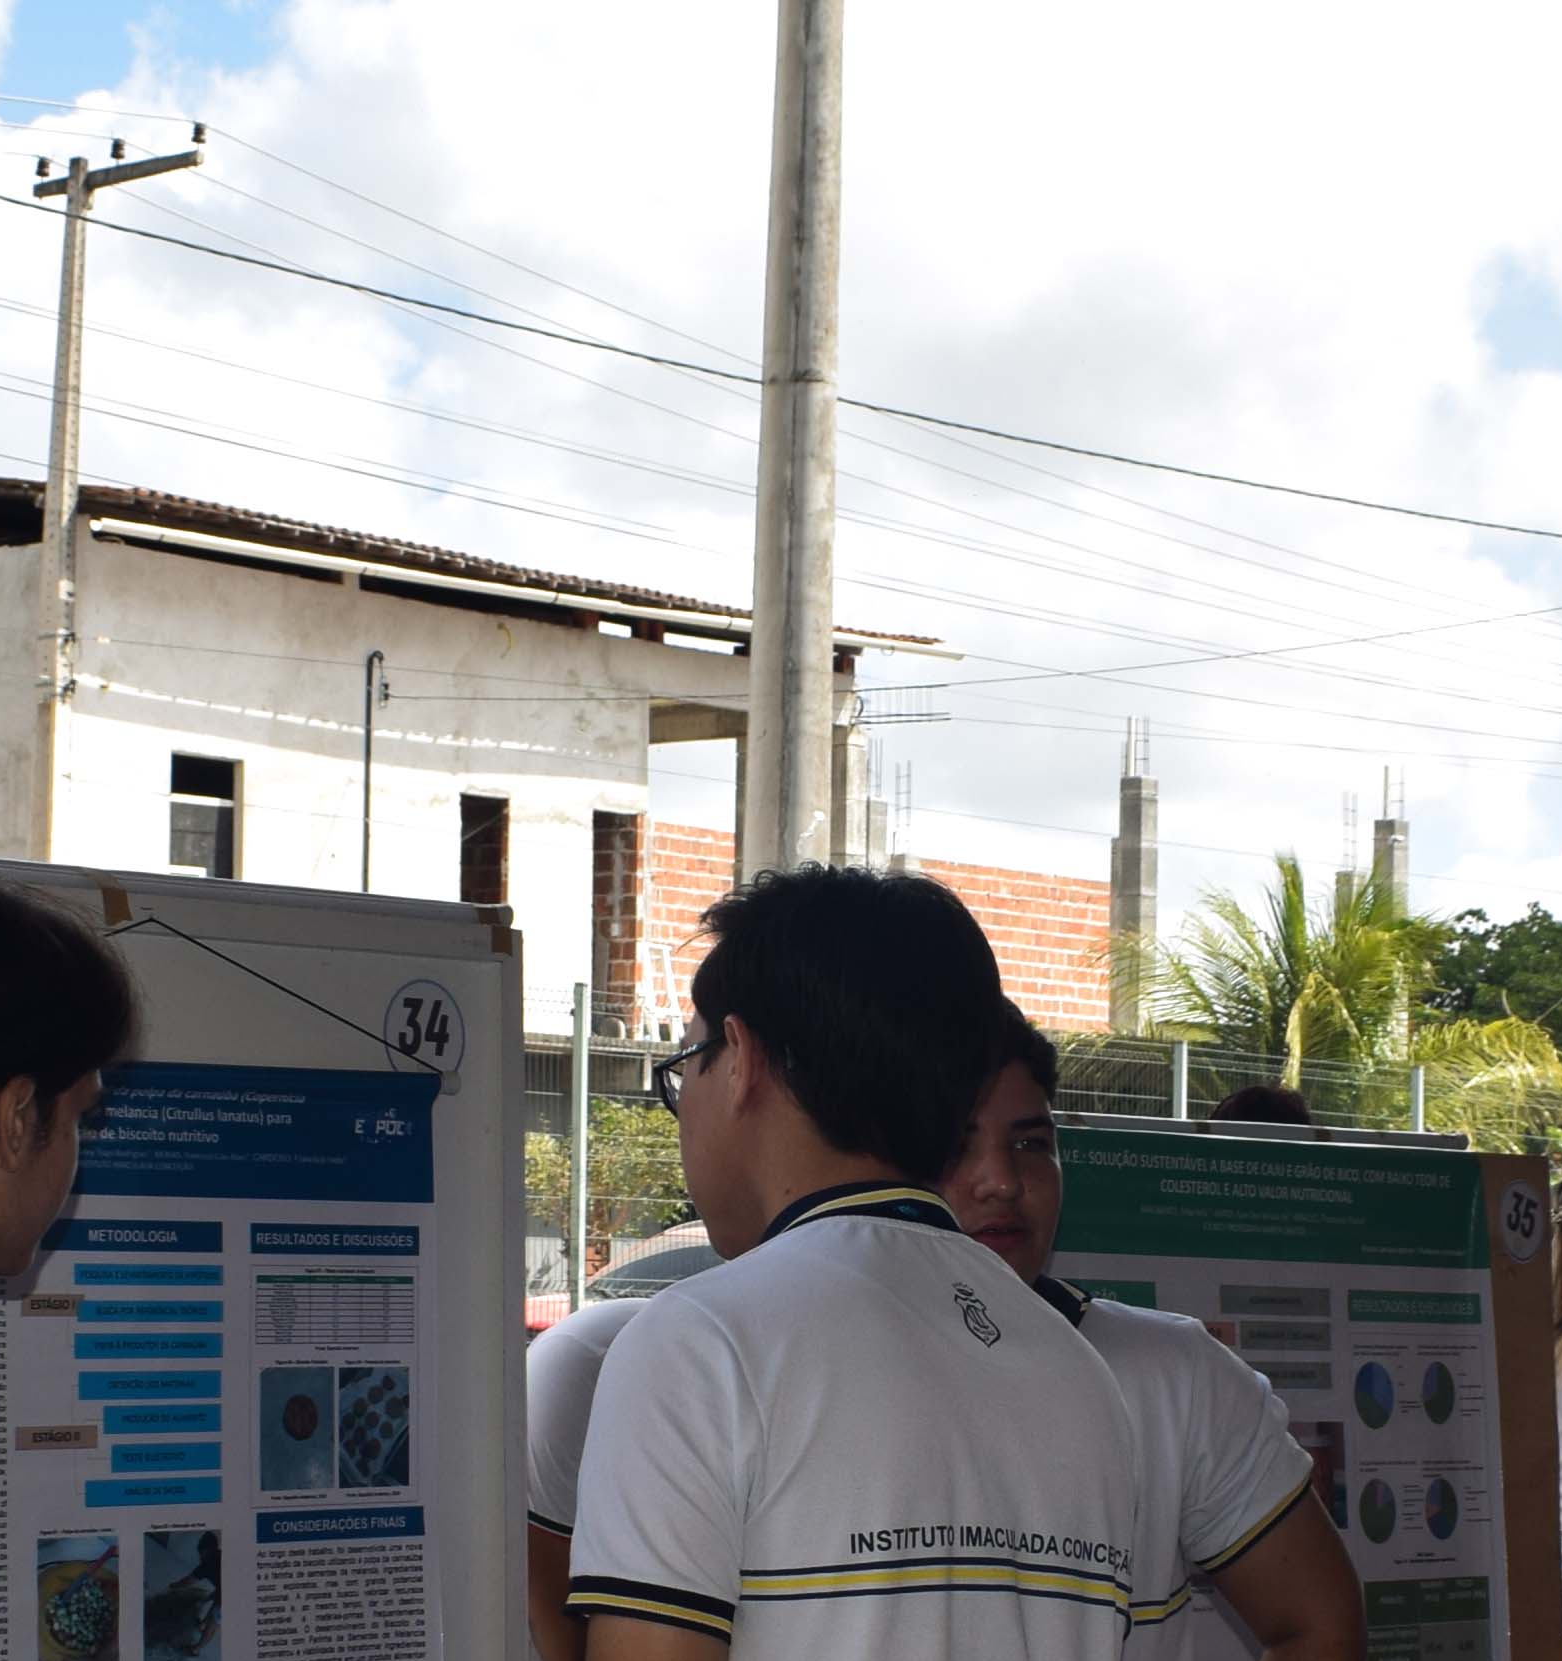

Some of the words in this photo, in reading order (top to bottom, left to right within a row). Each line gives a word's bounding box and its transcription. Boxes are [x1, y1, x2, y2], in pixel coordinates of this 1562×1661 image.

[398, 997, 449, 1056] 34
[105, 1104, 159, 1120] melancia
[161, 1106, 214, 1123] (Citrullus
[217, 1108, 264, 1126] lanatus)
[266, 1112, 293, 1126] para
[99, 1126, 117, 1141] de
[118, 1127, 167, 1142] biscoito
[168, 1130, 221, 1145] nutritivo
[1089, 1149, 1139, 1170] SOLUÇÃO
[1140, 1152, 1209, 1173] SUSTENTÁVEL
[1159, 1177, 1223, 1197] COLESTEROL
[1233, 1181, 1257, 1199] ALTO
[1258, 1183, 1288, 1201] VALOR
[1507, 1191, 1538, 1238] 35
[88, 1227, 178, 1244] METODOLOGIA
[255, 1231, 330, 1248] RESULTADOS
[332, 1233, 341, 1247] E
[343, 1231, 415, 1249] DISCUSSÕES
[30, 1297, 70, 1311] ESTÁGIO
[32, 1430, 72, 1444] ESTÁGIO
[272, 1516, 368, 1536] CONSIDERAÇÕES
[369, 1514, 407, 1531] FINAIS
[850, 1525, 955, 1554] INSTITUTO
[959, 1526, 1059, 1556] IMACULADA
